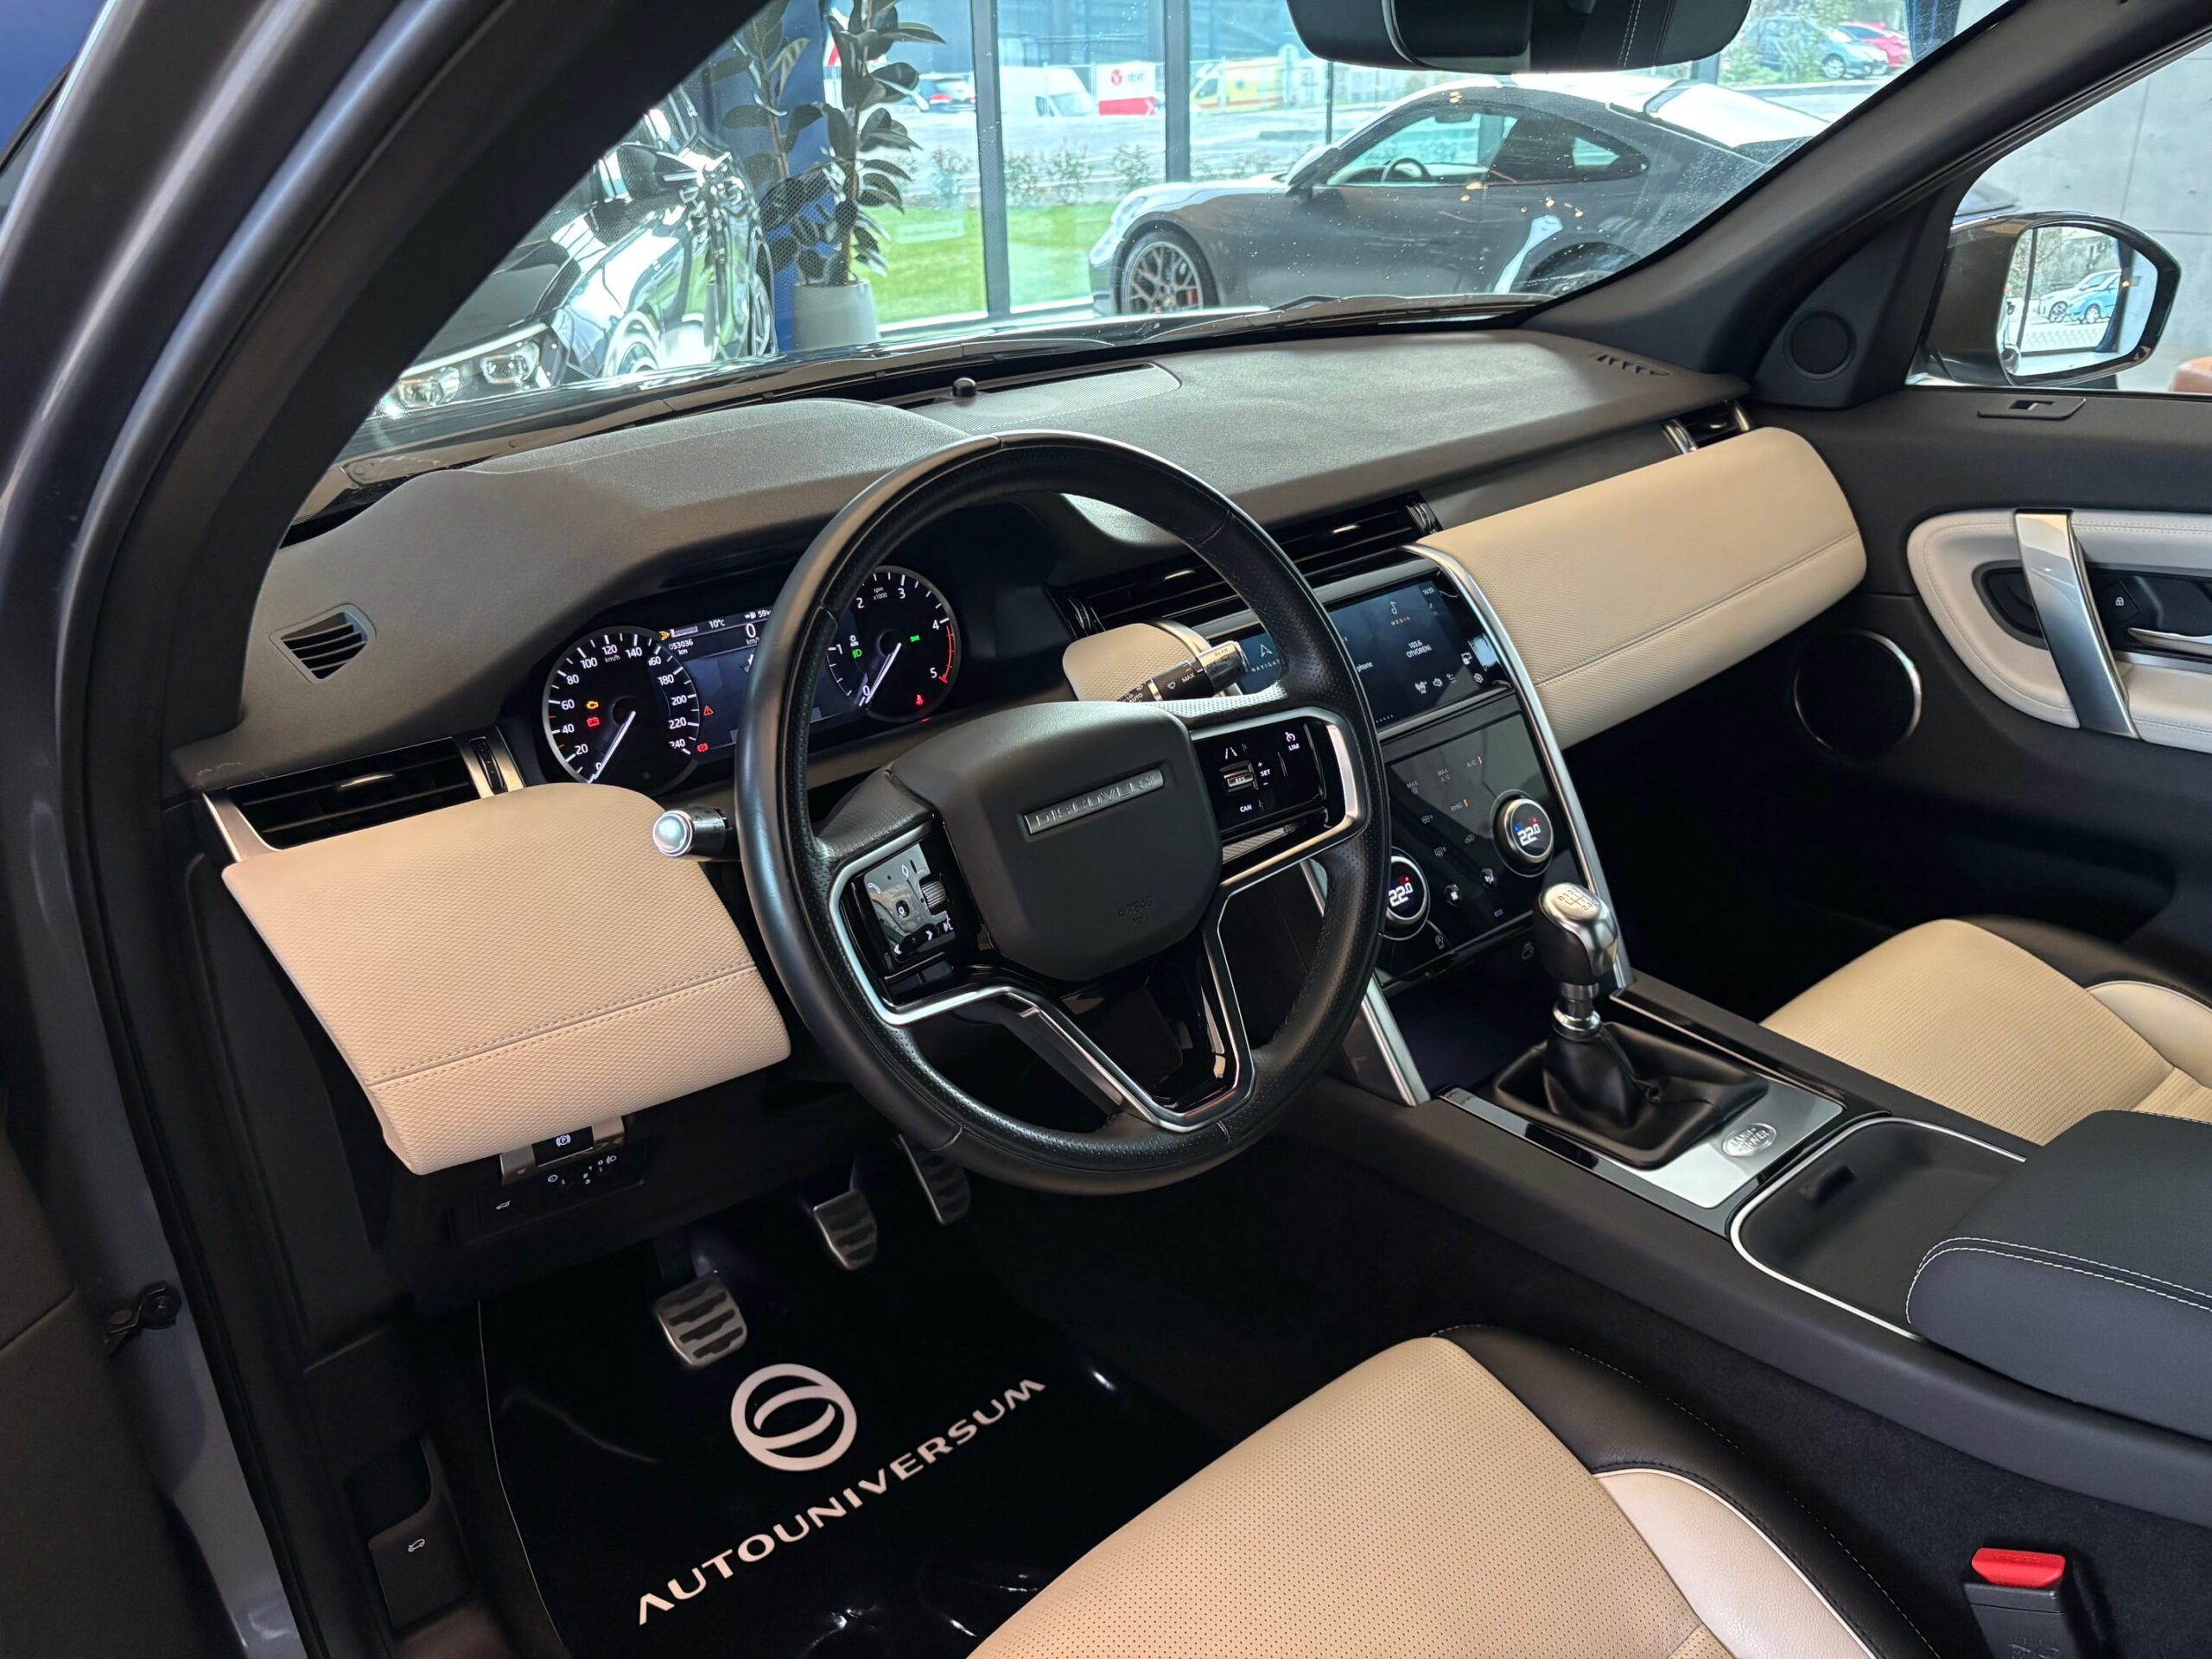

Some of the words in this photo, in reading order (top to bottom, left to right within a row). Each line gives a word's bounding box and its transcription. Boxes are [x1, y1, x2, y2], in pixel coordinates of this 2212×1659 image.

[898, 588, 906, 599] 3
[856, 597, 864, 608] 2
[746, 623, 756, 638] 0
[932, 620, 939, 630] 4
[602, 645, 618, 655] 120
[626, 647, 643, 658] 140
[580, 657, 598, 670] 100
[930, 667, 938, 678] 5
[1181, 672, 1196, 683] MAX
[566, 674, 580, 685] 80
[658, 674, 675, 686] 180
[863, 685, 870, 696] 0
[561, 699, 575, 710] 60
[671, 695, 687, 706] 200
[562, 723, 575, 734] 40
[669, 717, 687, 729] 220
[575, 743, 588, 755] 20
[1035, 774, 1155, 827] DISCOVERY
[1239, 804, 1253, 813] CAN
[639, 1378, 1046, 1626] AUTOUNIVERSUM
